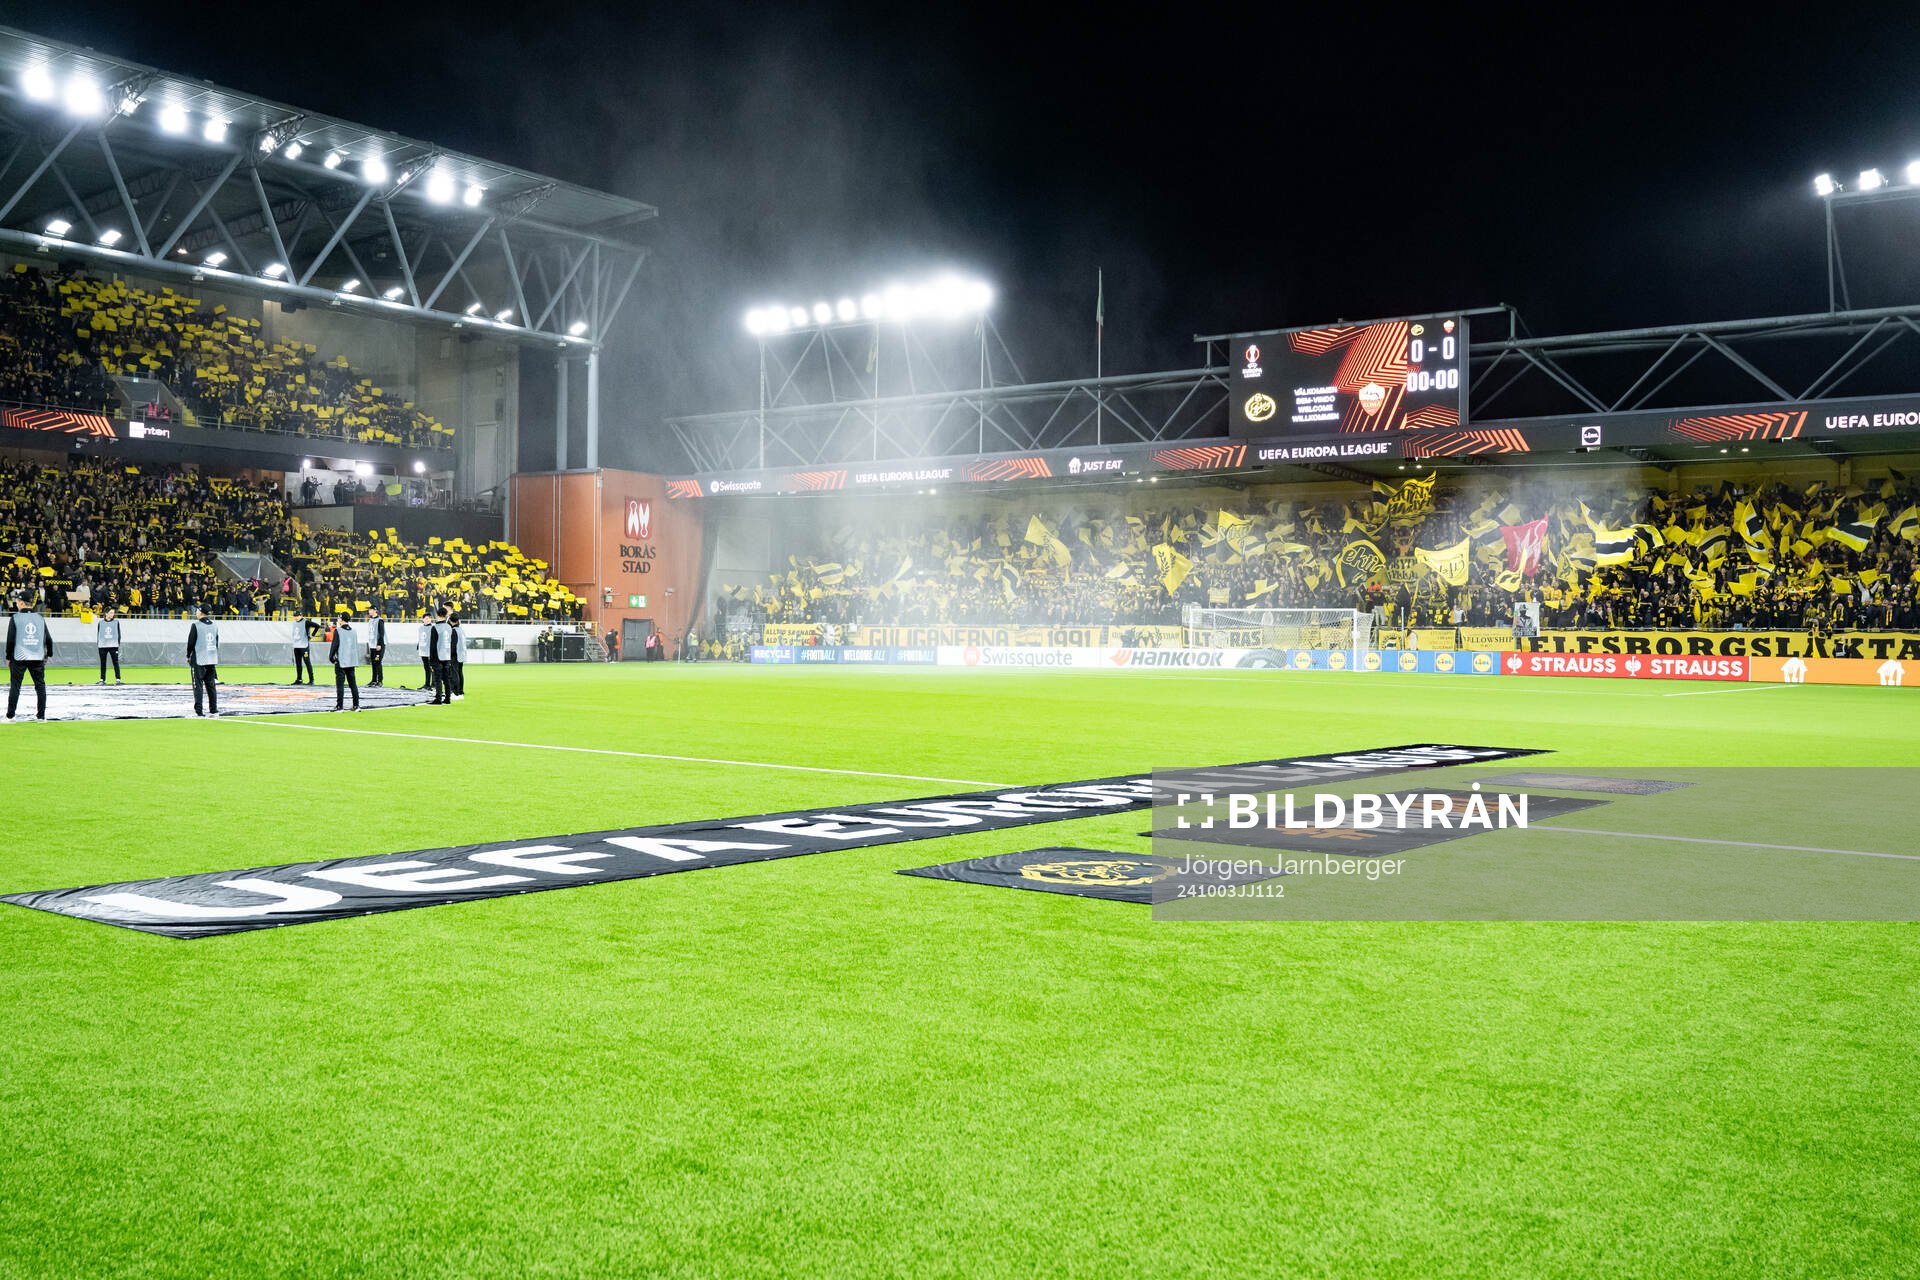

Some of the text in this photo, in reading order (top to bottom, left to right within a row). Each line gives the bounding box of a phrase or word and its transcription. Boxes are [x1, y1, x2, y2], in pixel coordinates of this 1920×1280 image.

[1411, 339, 1423, 362] 0
[1443, 336, 1455, 360] 0
[1407, 369, 1458, 392] 00:00
[1825, 411, 1920, 429] UEFA EURO
[1259, 448, 1289, 460] UEFA
[1292, 446, 1338, 459] EUROPA
[1083, 459, 1123, 472] JUST EAT
[856, 473, 878, 483] UEFA
[880, 471, 913, 482] EUROPA
[719, 480, 762, 492] Swissquote
[620, 543, 656, 559] BORÅS
[622, 560, 651, 573] STAD
[1047, 630, 1091, 647] 1991
[754, 649, 791, 659] RECYCLE
[982, 648, 1073, 666] Swissquote
[1530, 656, 1616, 673] STRAUSS
[1650, 659, 1743, 676] STRAUSS
[80, 836, 791, 918] UEFA
